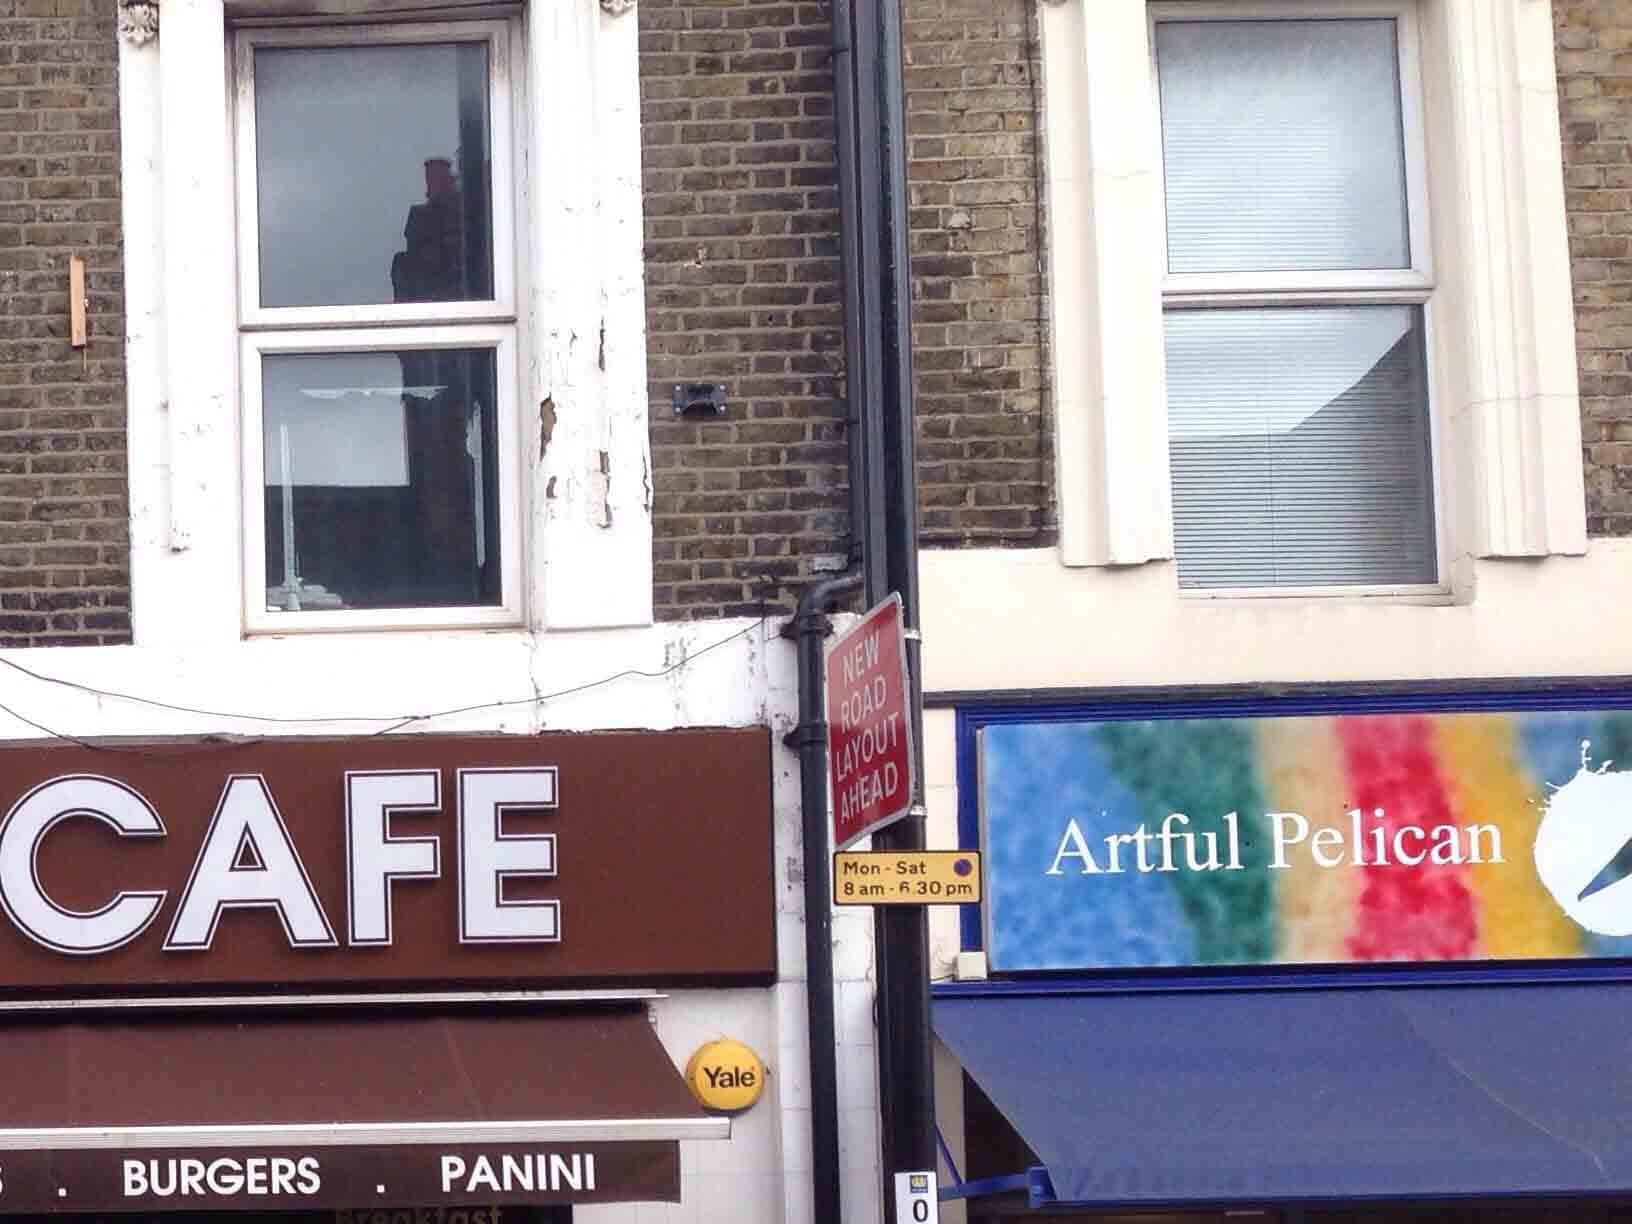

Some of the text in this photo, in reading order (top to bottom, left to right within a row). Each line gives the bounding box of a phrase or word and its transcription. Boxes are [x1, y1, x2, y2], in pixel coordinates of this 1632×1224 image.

[843, 630, 880, 686] NEW
[841, 675, 887, 734] ROAD
[835, 711, 899, 783] LAYOUT
[840, 761, 898, 824] AHEAD
[843, 861, 880, 875] Mon
[896, 860, 926, 875] Sat
[1045, 807, 1507, 875] Artful Pelican
[844, 881, 854, 896] 8
[859, 884, 885, 895] am
[946, 885, 972, 897] pm
[703, 1066, 755, 1088] Yale
[123, 1157, 321, 1196] BURGERS
[441, 1153, 595, 1192] PANINI
